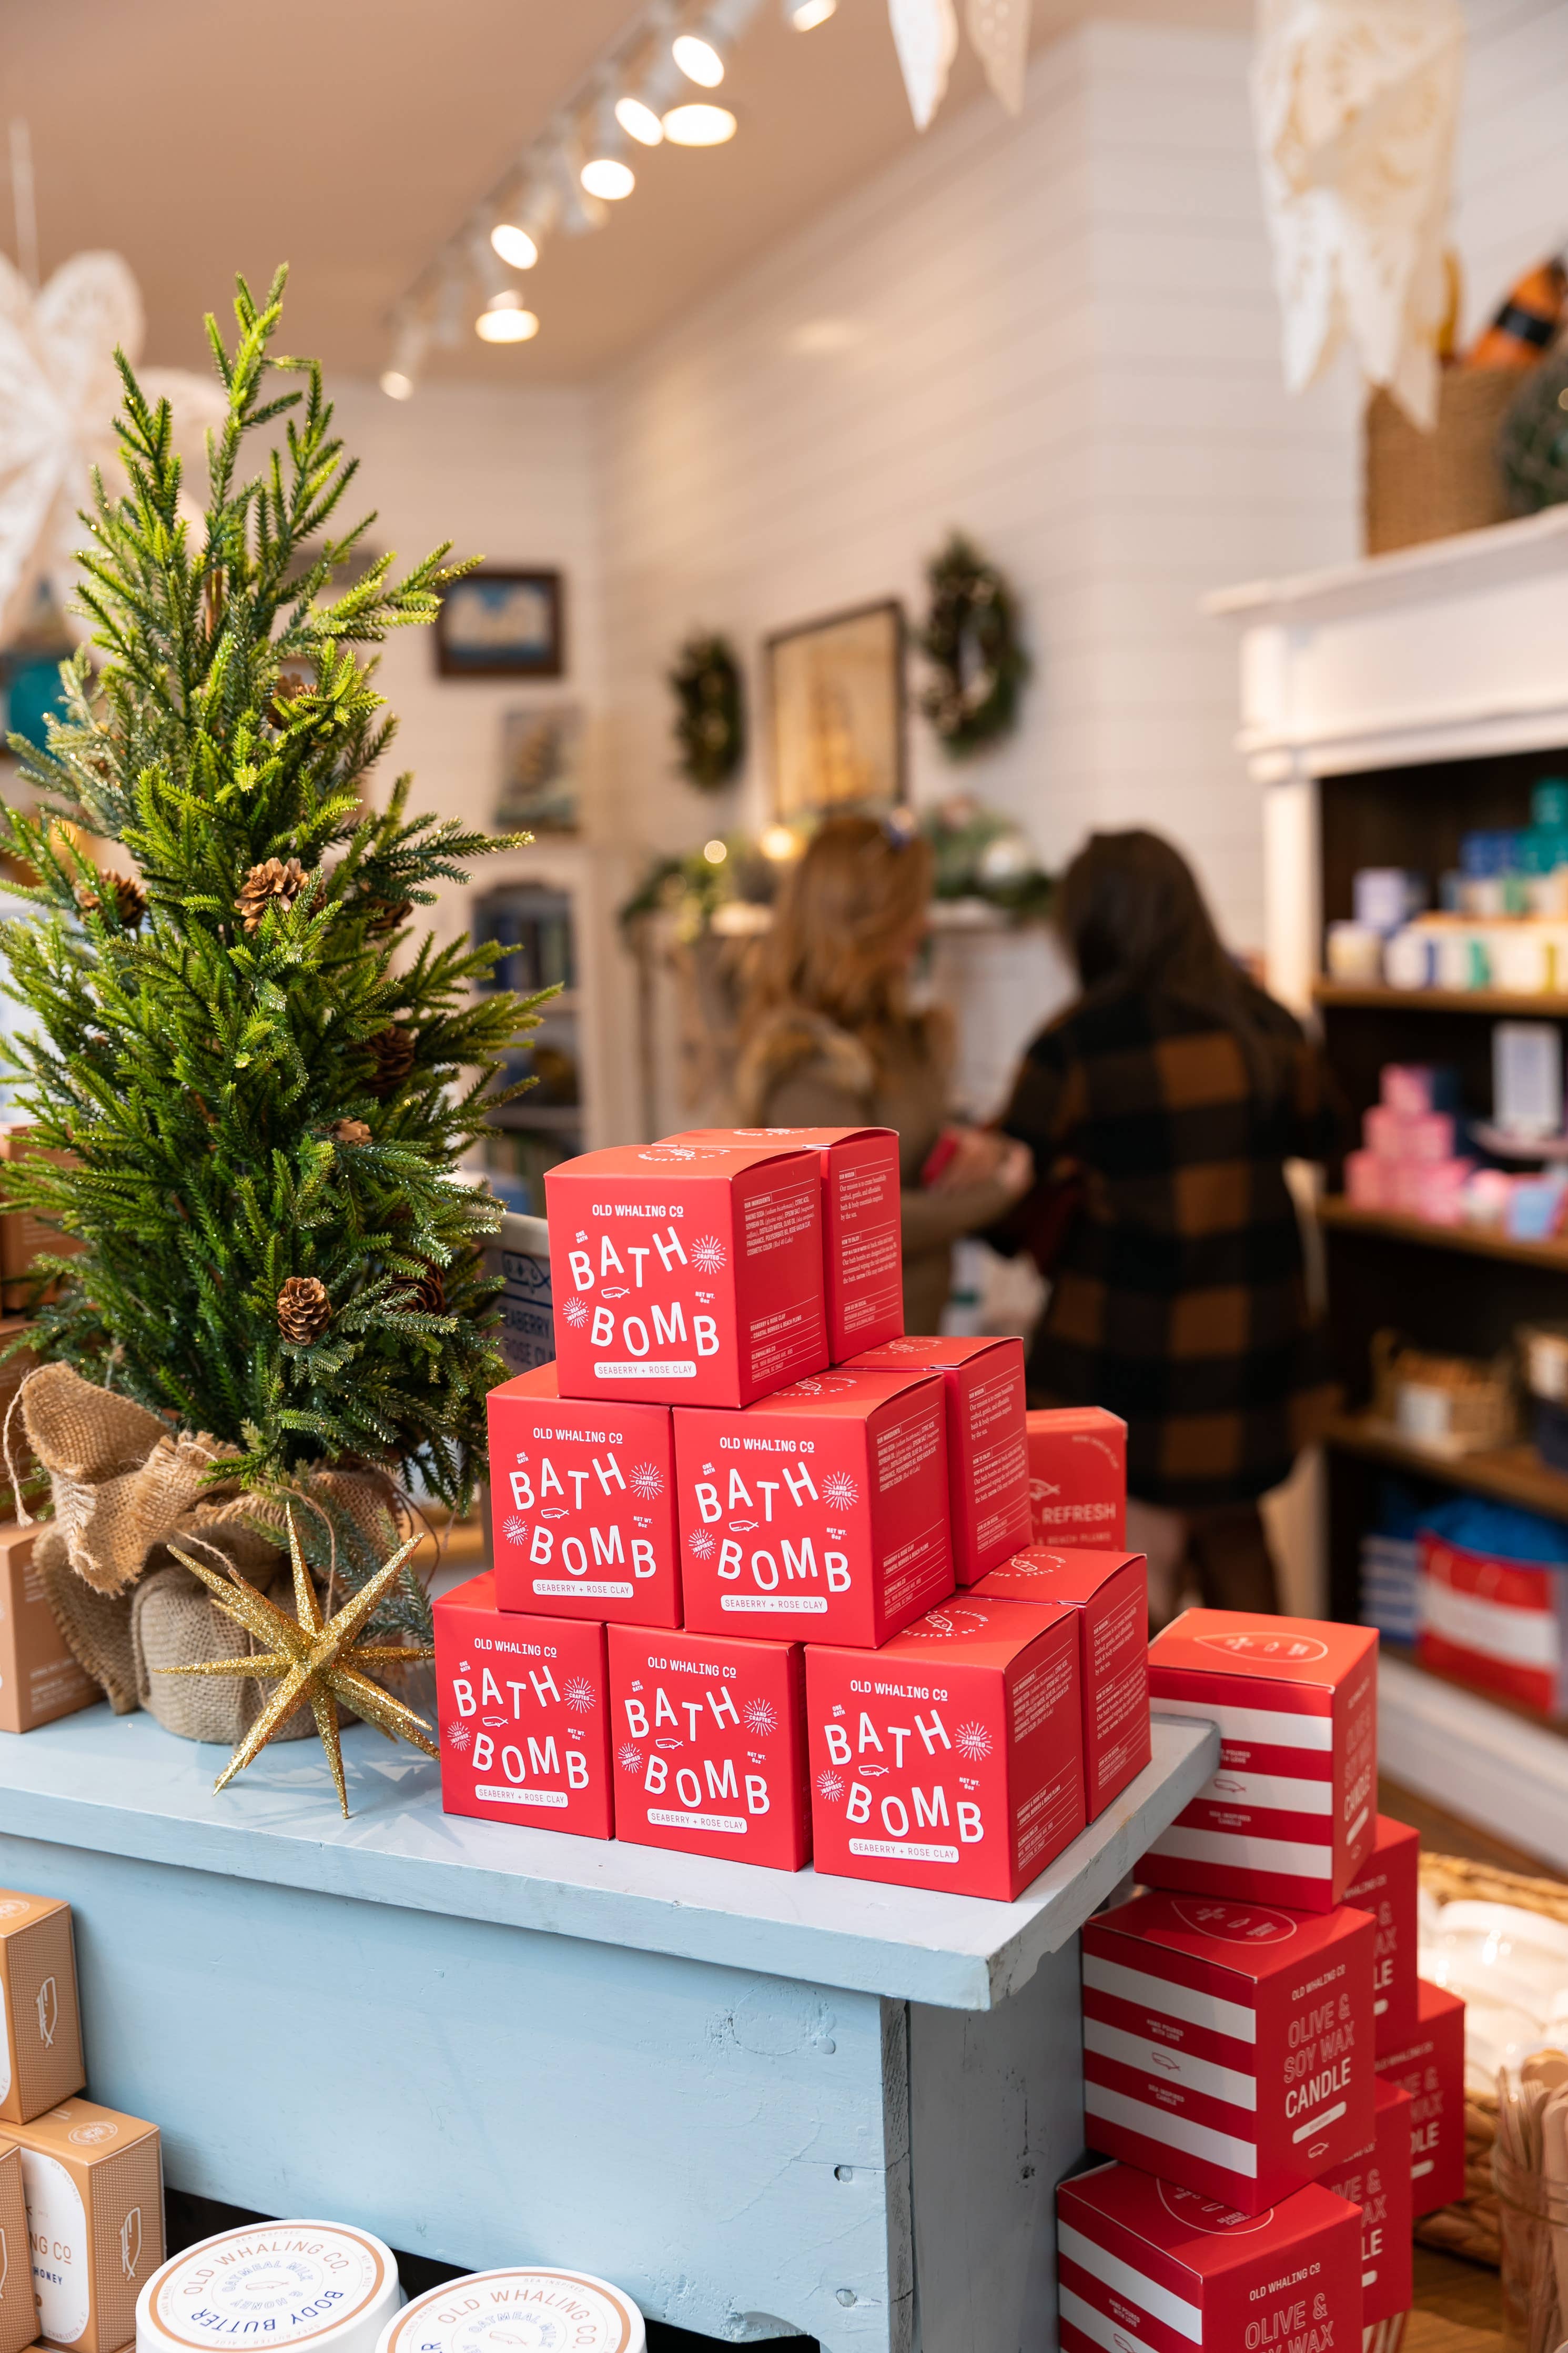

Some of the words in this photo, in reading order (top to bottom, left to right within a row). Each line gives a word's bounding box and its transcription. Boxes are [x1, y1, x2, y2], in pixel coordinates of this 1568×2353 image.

[592, 1204, 612, 1216] OLD
[614, 1204, 666, 1218] WHALING
[575, 1230, 586, 1238] ONE
[576, 1234, 589, 1244] BATH
[568, 1226, 688, 1291] BATH
[567, 1309, 586, 1321] INSPIRED
[590, 1301, 720, 1356] BOMB
[599, 1366, 637, 1374] SEABERRY
[533, 1427, 553, 1440] OLD
[555, 1429, 606, 1443] WHALING
[720, 1437, 741, 1449] OLD
[743, 1438, 796, 1452] WHALING
[517, 1456, 529, 1464] BATH
[509, 1452, 626, 1510] BATH
[703, 1467, 716, 1476] BATH
[694, 1461, 819, 1523] BATH
[1042, 1503, 1116, 1524] REFRESH
[507, 1527, 525, 1538] INSPIRED
[529, 1525, 656, 1578] BOMB
[693, 1541, 713, 1553] INSPIRED
[717, 1537, 852, 1592] BOMB
[537, 1583, 575, 1592] SEABERRY
[726, 1599, 766, 1607] SEABERRY
[474, 1637, 492, 1650] OLD
[494, 1640, 541, 1656] WHALING
[648, 1656, 667, 1670] OLD
[670, 1660, 720, 1676] WHALING
[452, 1665, 561, 1720] BATH
[850, 1680, 872, 1693] OLD
[874, 1682, 929, 1700] WHALING
[624, 1686, 740, 1742] BATH
[832, 1704, 843, 1713] ONE
[451, 1734, 468, 1743] INSPIRED
[824, 1709, 952, 1768] BATH
[472, 1732, 589, 1789] BOMB
[622, 1756, 640, 1765] INSPIRED
[644, 1754, 770, 1814] BOMB
[822, 1784, 842, 1794] INSPIRED
[479, 1788, 514, 1799] SEABERRY
[525, 1793, 544, 1802] ROSE
[547, 1795, 564, 1804] CLAY
[652, 1812, 689, 1824] SEABERRY
[701, 1818, 721, 1827] ROSE
[724, 1821, 743, 1829] CLAY
[846, 1782, 984, 1843] BOMB
[854, 1842, 895, 1854] SEABERRY
[908, 1847, 930, 1856] ROSE
[934, 1850, 954, 1859] CLAY
[1292, 1986, 1305, 2000] OLD
[1306, 1969, 1336, 1993] WHALING
[1289, 2000, 1334, 2048] OLIVE
[1339, 1993, 1350, 2020] &
[1283, 2043, 1317, 2084] SOY
[1320, 2020, 1354, 2063] WAX
[1286, 2057, 1351, 2118] CANDLE
[184, 2269, 214, 2295] OLD
[214, 2241, 324, 2265] WHALING
[323, 2252, 349, 2274] CO.
[222, 2260, 281, 2292] OATMEAL
[287, 2261, 313, 2281] MILK
[1249, 2286, 1266, 2301] OLD
[1268, 2268, 1308, 2293] WHALING
[230, 2298, 288, 2310] HONEY
[291, 2290, 344, 2325] BODY
[191, 2308, 276, 2333] BUTTER
[438, 2299, 480, 2324] OLD
[490, 2289, 590, 2320] WHALING
[572, 2325, 596, 2348] CO.
[1245, 2300, 1306, 2350] OLIVE
[1313, 2293, 1328, 2320] &
[469, 2311, 541, 2333] OATMEAL
[539, 2322, 557, 2348] MILK
